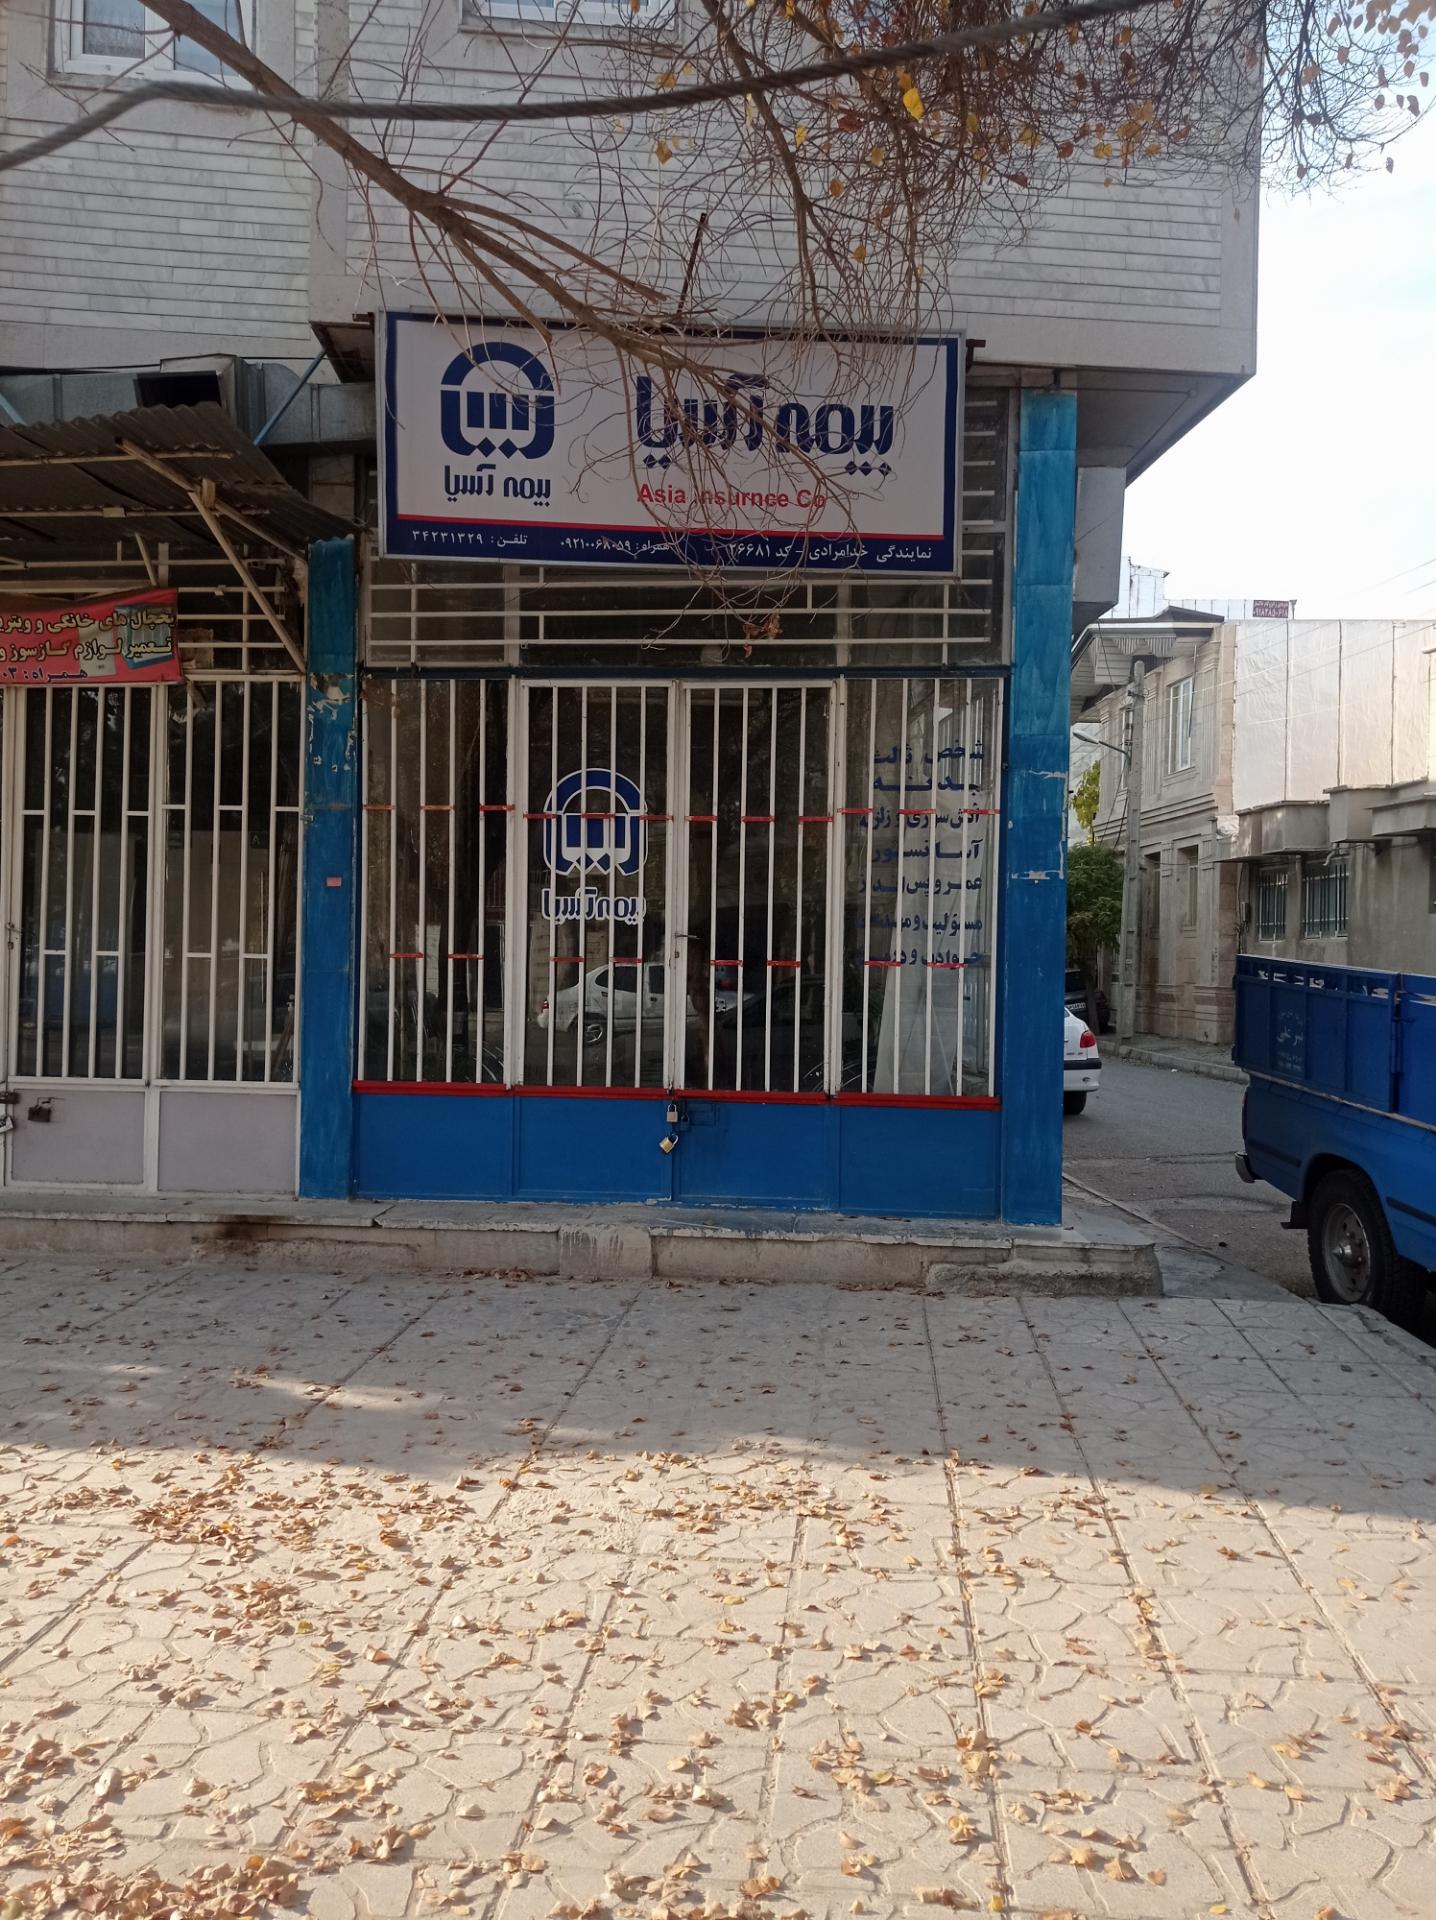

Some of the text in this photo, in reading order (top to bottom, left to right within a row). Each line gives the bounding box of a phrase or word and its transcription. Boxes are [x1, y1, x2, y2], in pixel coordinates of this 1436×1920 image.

[636, 373, 894, 477] بیمه آسیا
[444, 463, 551, 507] بیمه آسیا
[637, 484, 827, 509] Asia nsurnce Co
[412, 530, 484, 545] ۳۴۲۳۱۳۲۹
[876, 543, 932, 563] نمایندگی
[48, 613, 96, 634] خانگی
[126, 636, 173, 659] تعمیر
[873, 743, 912, 765] ثلث
[595, 896, 646, 926] یمه
